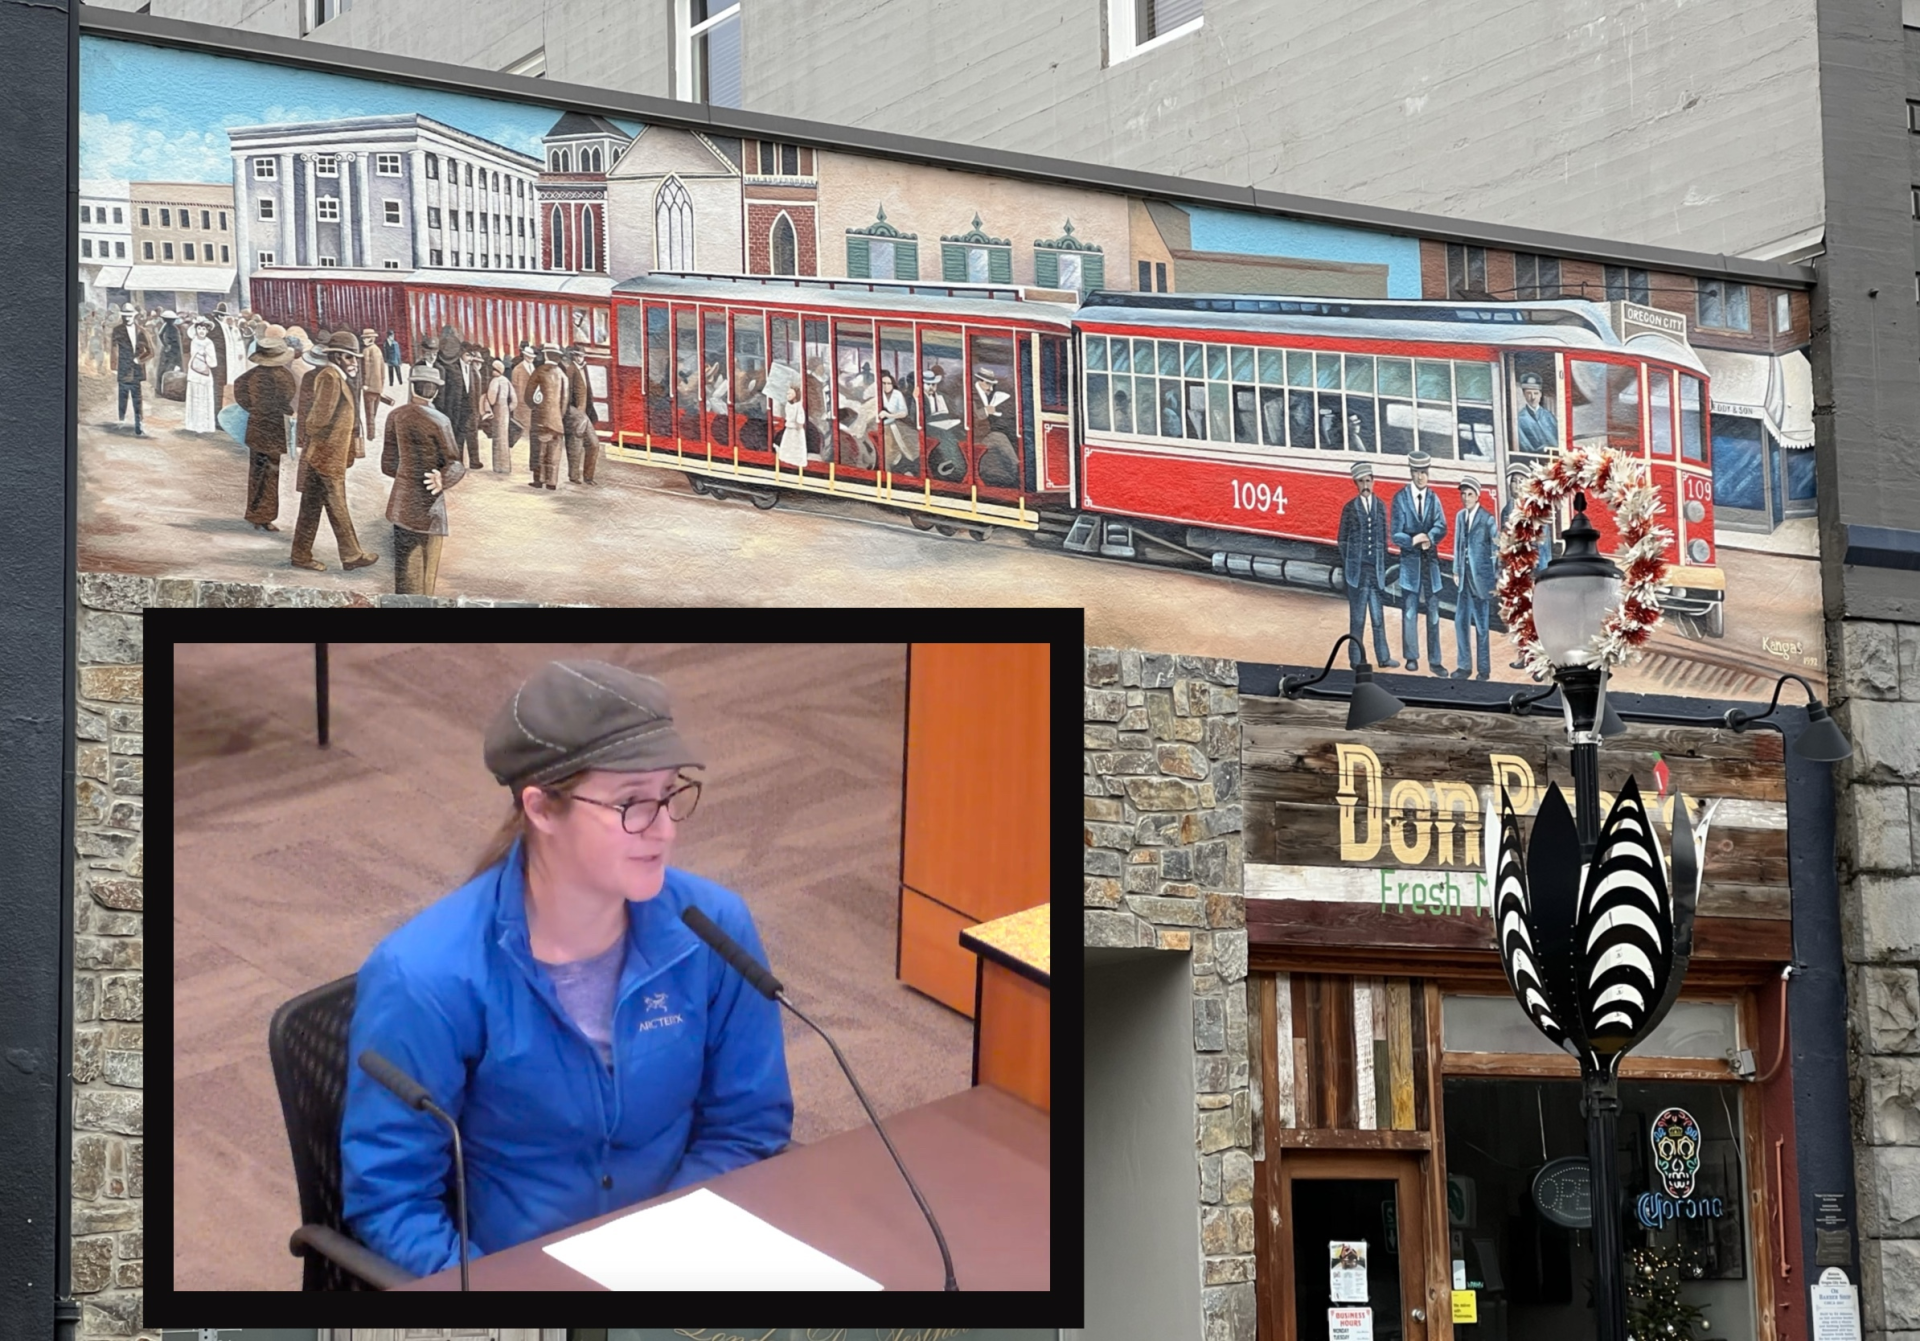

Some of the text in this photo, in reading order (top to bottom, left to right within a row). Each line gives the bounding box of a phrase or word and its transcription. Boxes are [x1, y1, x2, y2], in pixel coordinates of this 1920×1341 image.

[1627, 308, 1683, 331] OREGON CITY
[1738, 406, 1753, 415] SON
[1231, 479, 1288, 515] 1094
[1688, 479, 1712, 502] 109
[1762, 636, 1803, 660] Kangas
[1335, 742, 1483, 867] Don
[1380, 868, 1461, 917] Fresh
[1538, 1177, 1592, 1211] OPE
[1637, 1192, 1723, 1229] Corona
[1335, 1312, 1366, 1320] BUSINESS
[1340, 1319, 1362, 1327] HOURS
